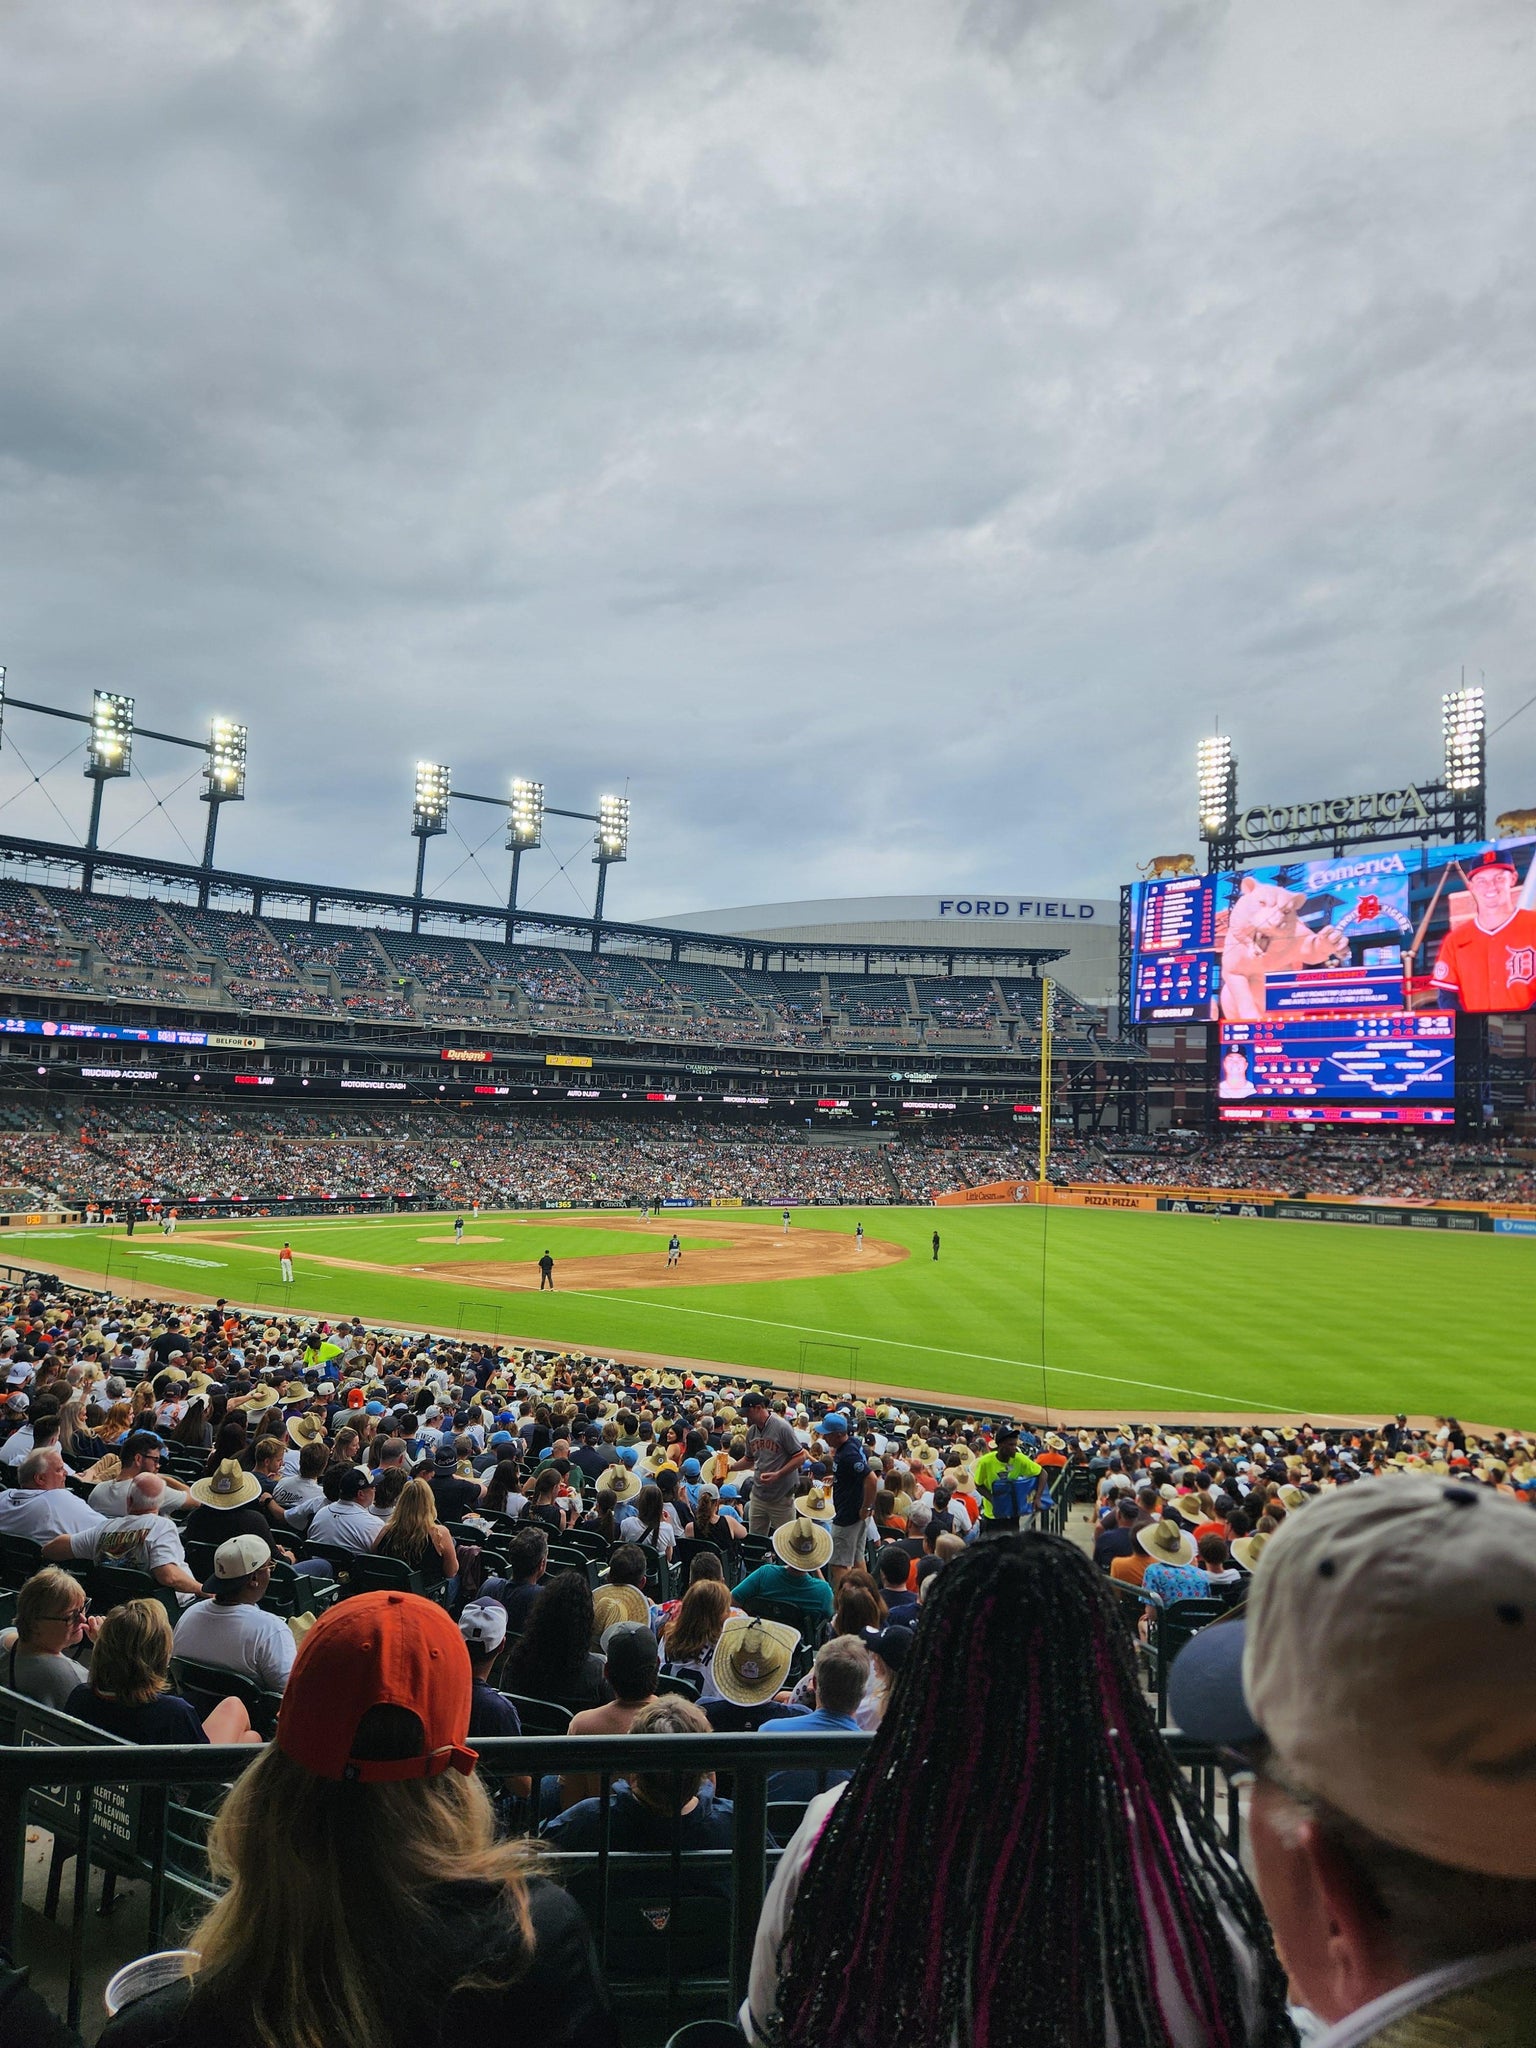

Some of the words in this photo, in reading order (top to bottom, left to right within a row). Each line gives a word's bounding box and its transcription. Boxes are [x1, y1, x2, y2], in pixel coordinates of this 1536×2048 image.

[1287, 822, 1376, 846] PARK
[940, 900, 1009, 916] FORD
[1019, 902, 1095, 919] FIELD
[81, 1068, 121, 1078] TRUCKING
[121, 1070, 158, 1080] ACCIDENT
[341, 1080, 384, 1089] MOTORCYCLE
[385, 1082, 406, 1090] CRASH
[904, 1072, 938, 1081] Gallagher
[545, 1200, 571, 1208] bet365
[1084, 1196, 1111, 1206] PIZZA!
[1112, 1198, 1140, 1208] PIZZA!
[112, 1794, 125, 1808] FOR
[103, 1803, 130, 1826] LEAVING
[112, 1823, 131, 1841] FIELD
